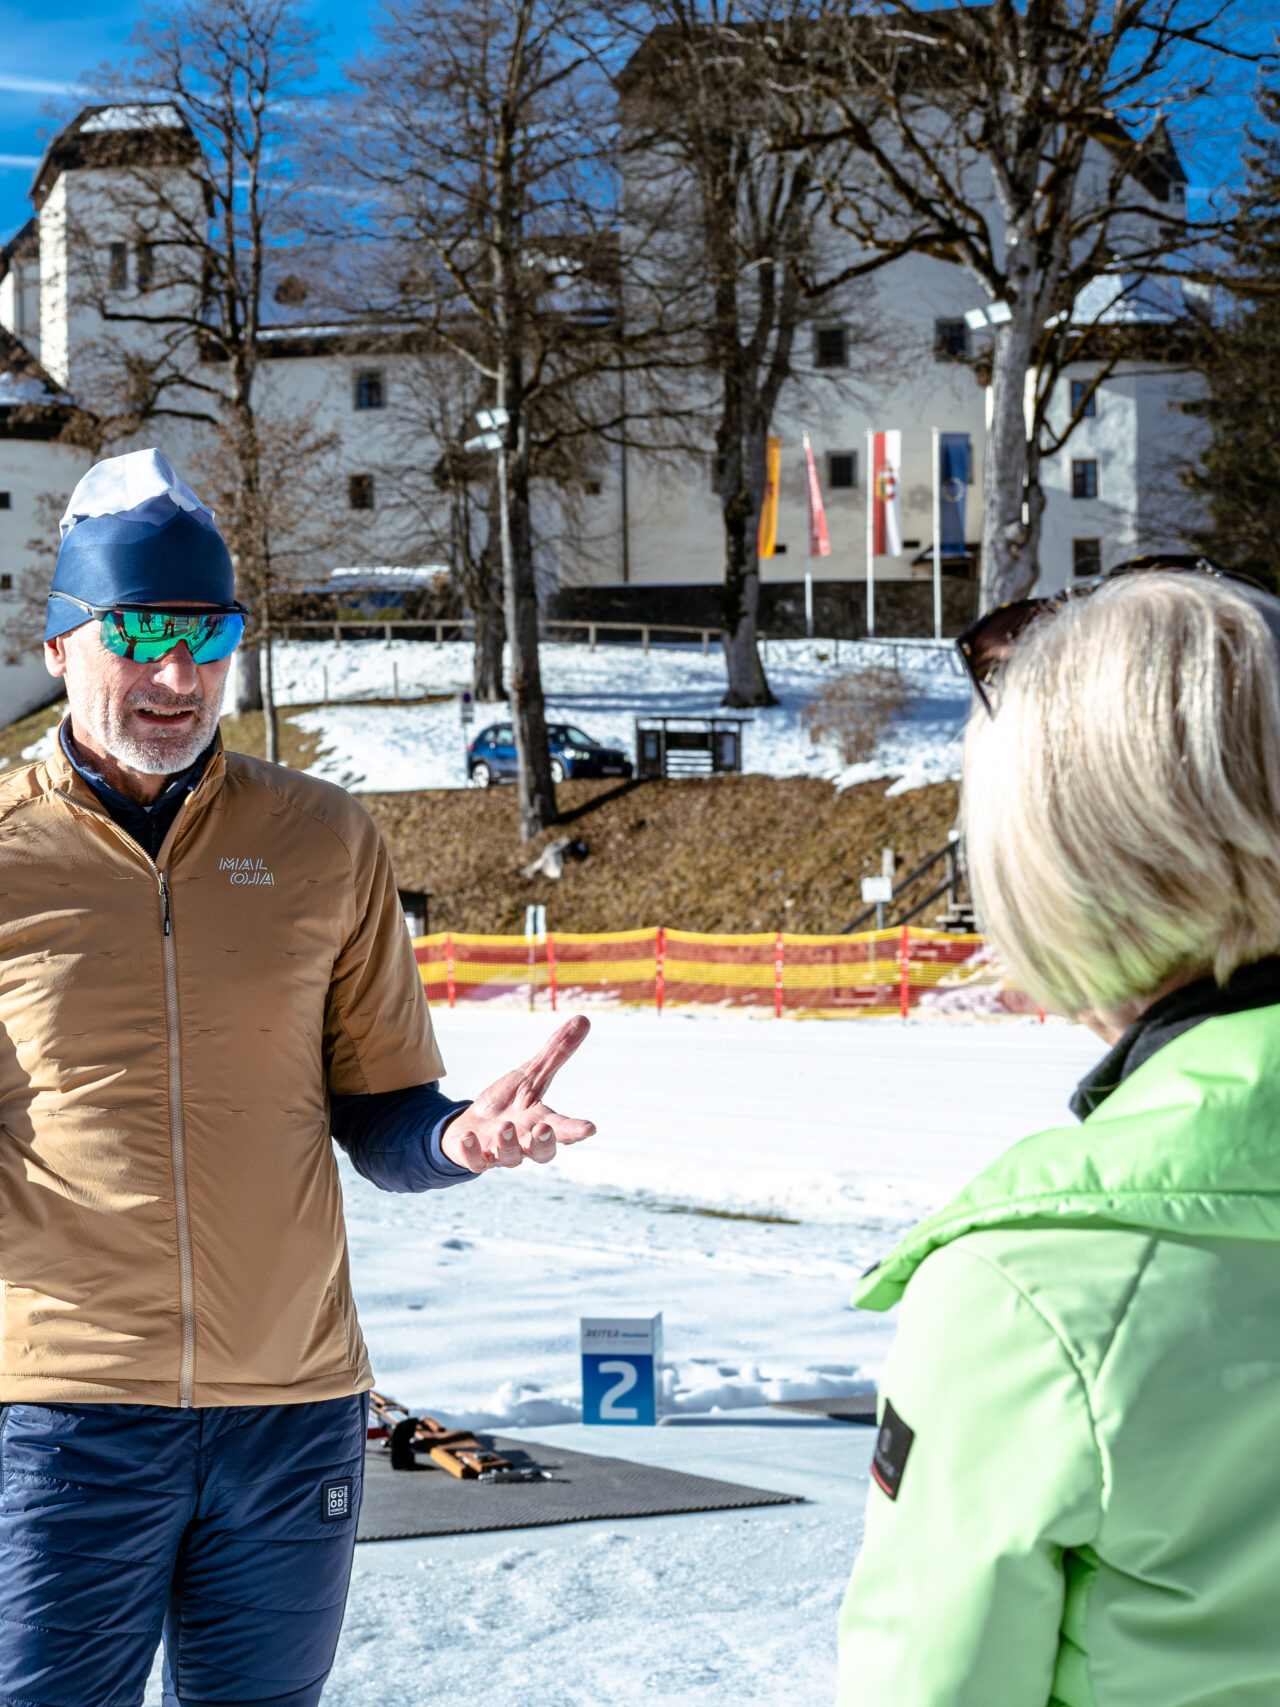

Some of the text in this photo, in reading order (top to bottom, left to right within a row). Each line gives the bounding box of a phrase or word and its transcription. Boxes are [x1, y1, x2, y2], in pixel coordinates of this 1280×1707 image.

[218, 857, 268, 871] MAL
[230, 871, 275, 886] OJA
[598, 1360, 638, 1420] 2
